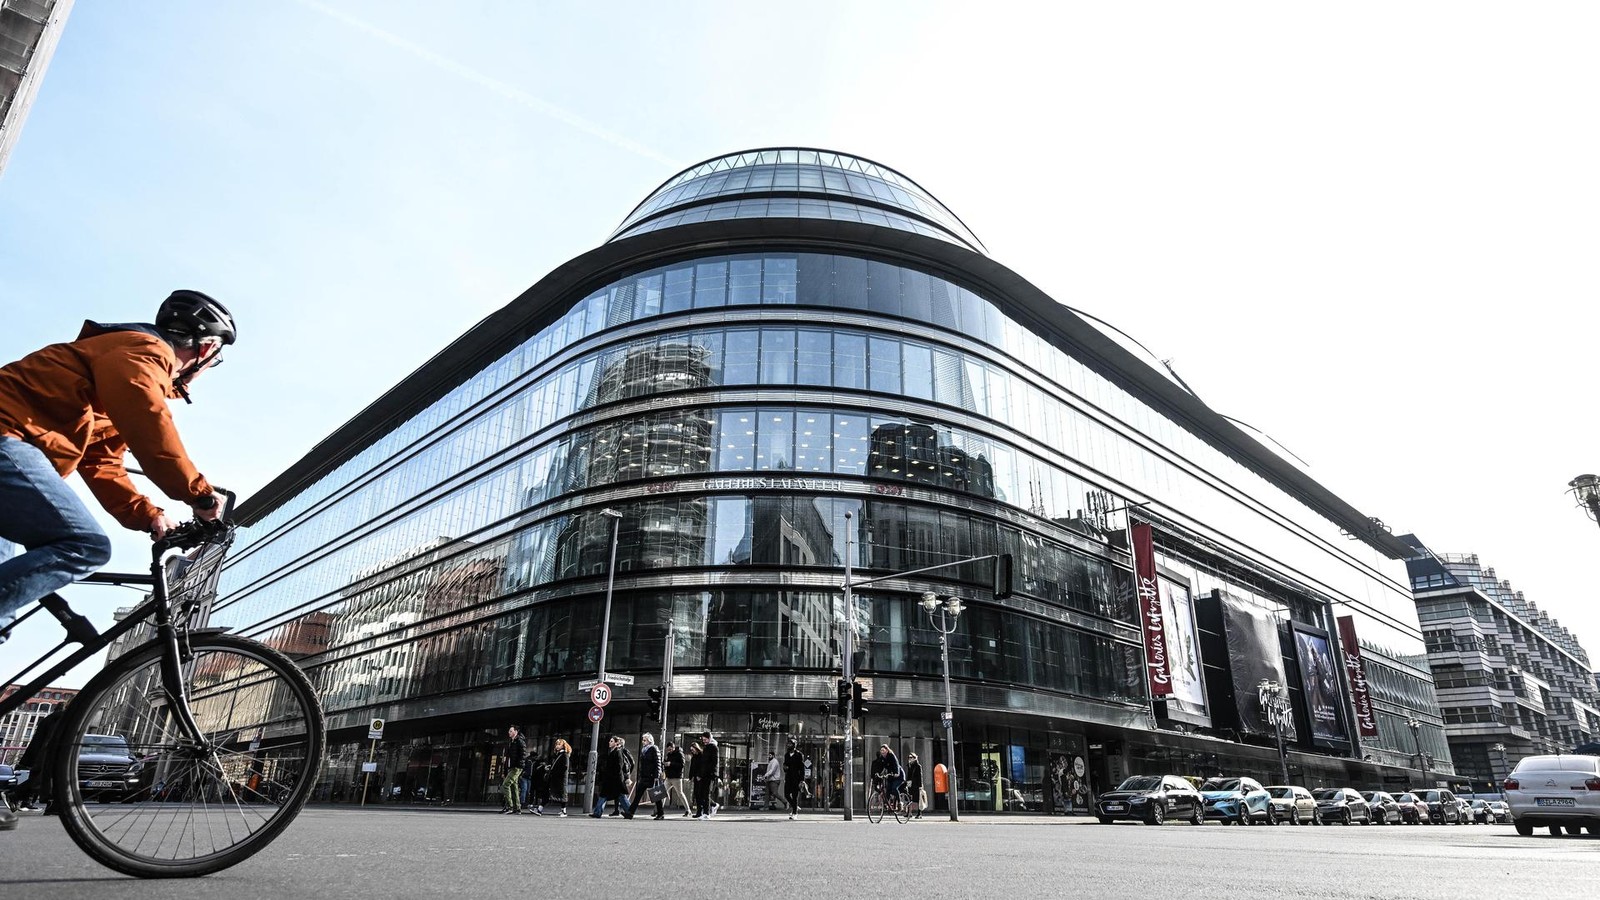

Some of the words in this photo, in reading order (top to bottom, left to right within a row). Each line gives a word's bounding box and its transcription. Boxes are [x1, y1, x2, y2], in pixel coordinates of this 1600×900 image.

[1139, 573, 1162, 631] Lafayette
[1147, 633, 1172, 684] Galeries
[595, 689, 608, 701] 30
